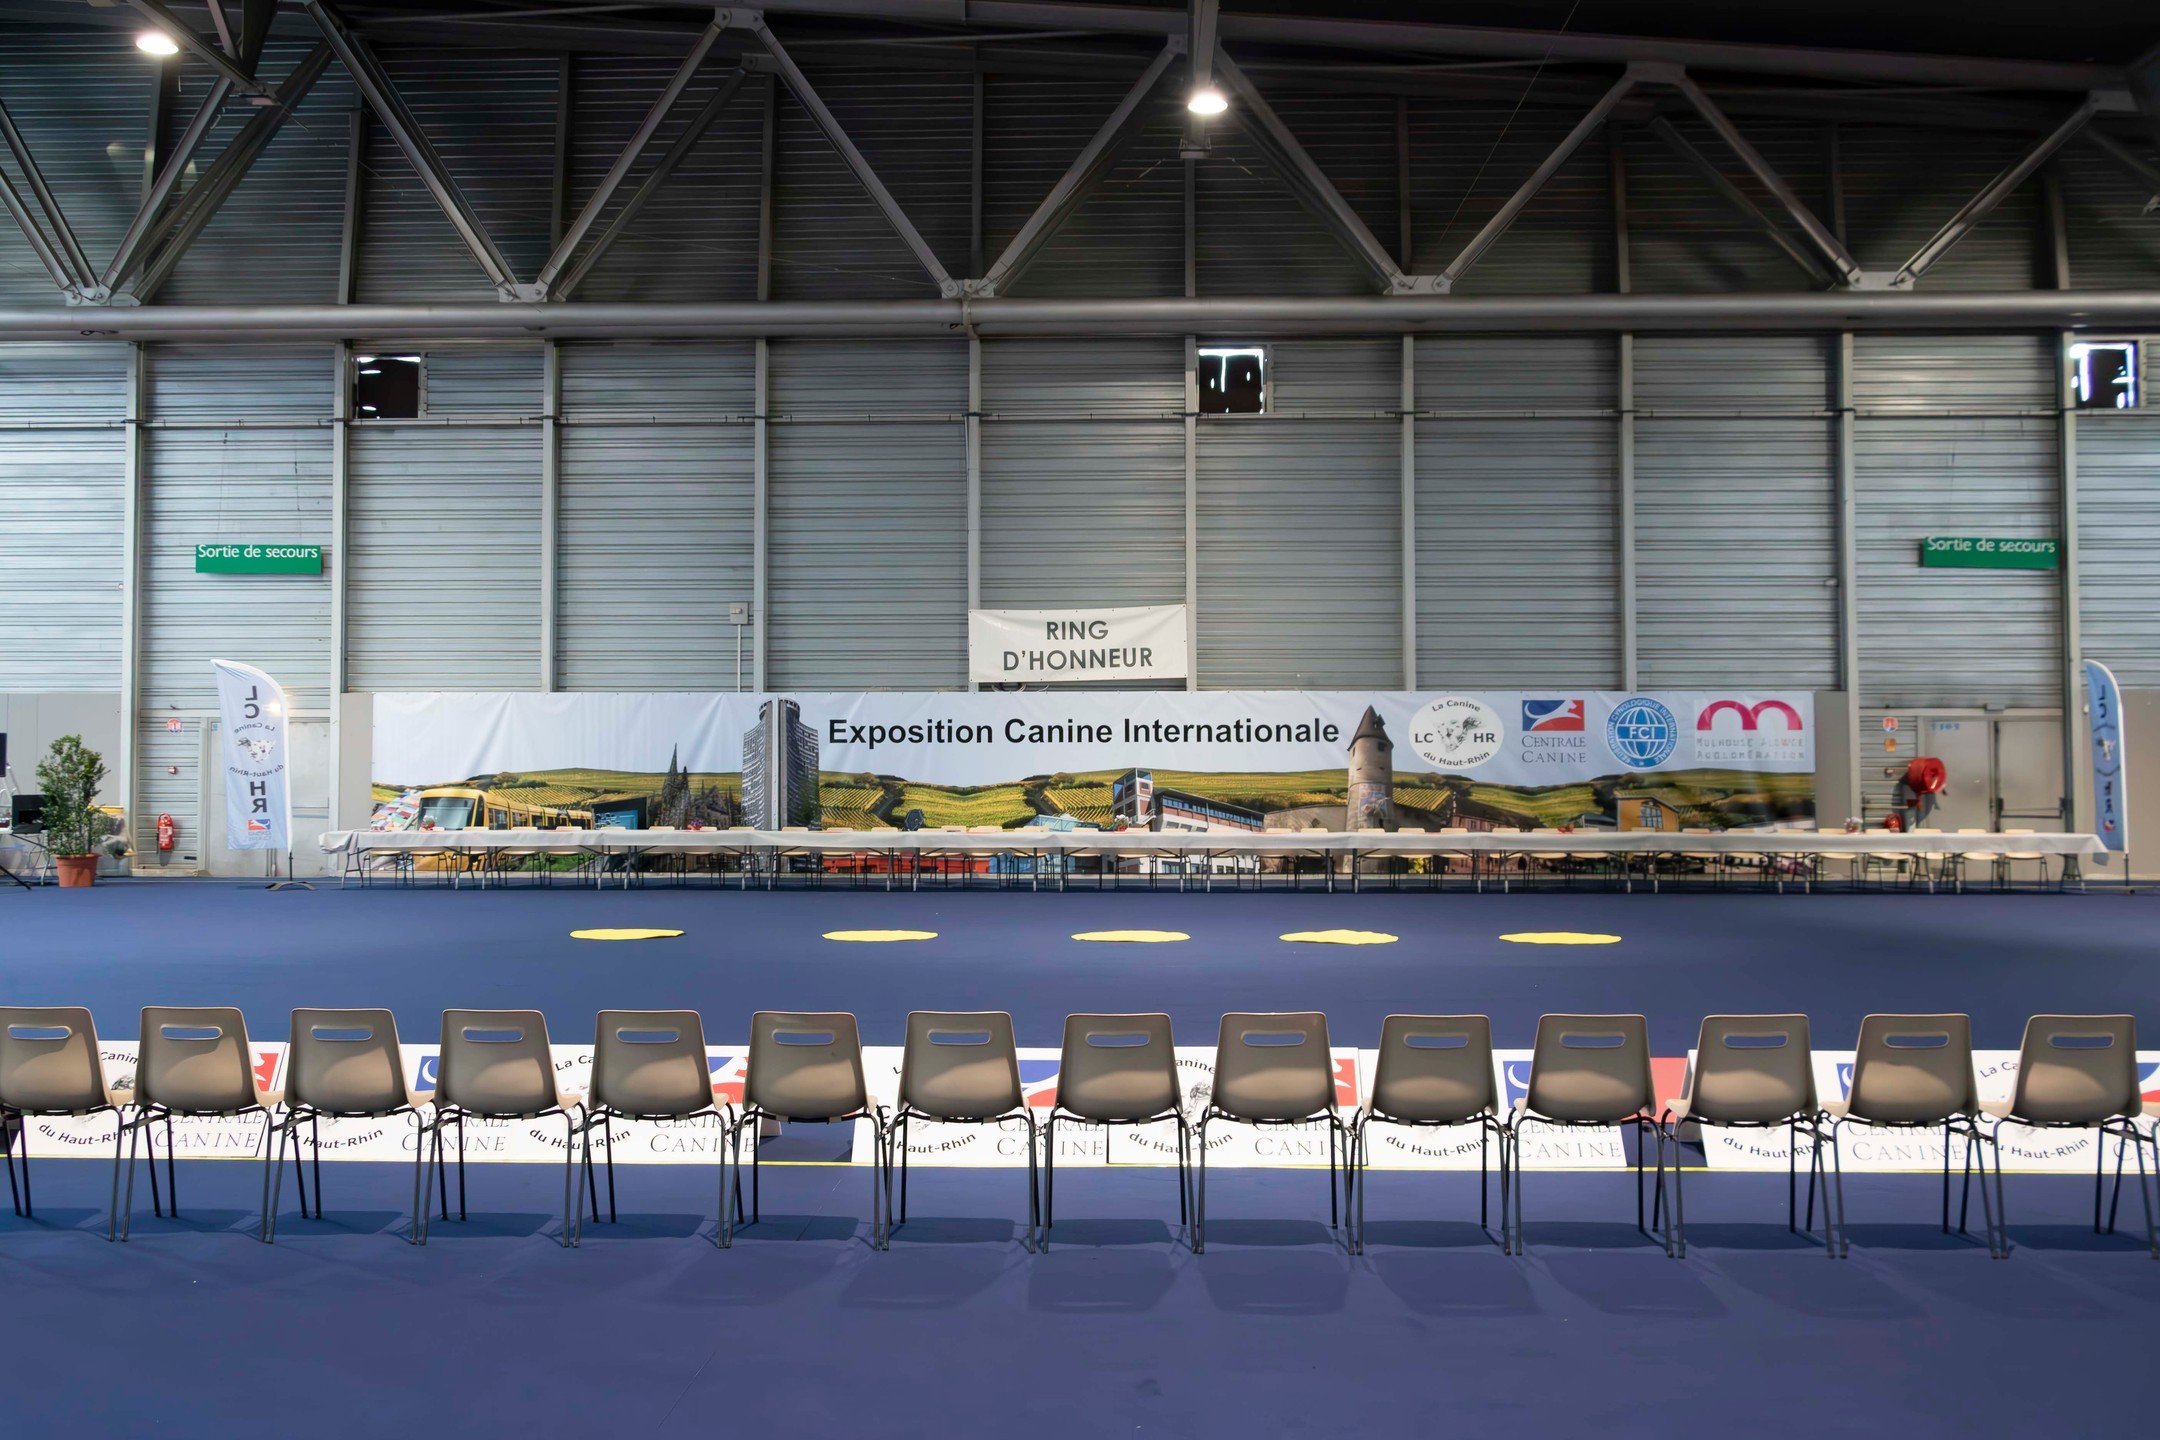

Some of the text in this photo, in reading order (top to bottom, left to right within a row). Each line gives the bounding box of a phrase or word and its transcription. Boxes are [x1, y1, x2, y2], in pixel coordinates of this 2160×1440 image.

[198, 544, 318, 558] Sortie de secours
[1927, 536, 2056, 553] Sortie de secours
[1046, 620, 1109, 640] RING
[1003, 647, 1153, 671] D'HONNEUR
[1432, 700, 1481, 712] La Canine
[829, 717, 1340, 750] Exposition Canine Internationale
[1414, 732, 1496, 743] LC HR
[1629, 726, 1655, 739] FCI
[1521, 735, 1586, 748] CENTRALE
[1423, 751, 1491, 766] du Haut-Rhin
[1521, 750, 1587, 763] CANINE
[101, 1051, 139, 1065] Canin
[555, 1060, 572, 1071] La
[1175, 1059, 1216, 1074] anine
[1980, 1067, 1998, 1078] La
[39, 1124, 56, 1138] du
[529, 1129, 548, 1143] du
[155, 1129, 259, 1148] CANINE
[1129, 1133, 1148, 1147] du
[1386, 1136, 1405, 1150] du
[1723, 1137, 1744, 1150] du
[2011, 1138, 2089, 1159] Haut-Rhin
